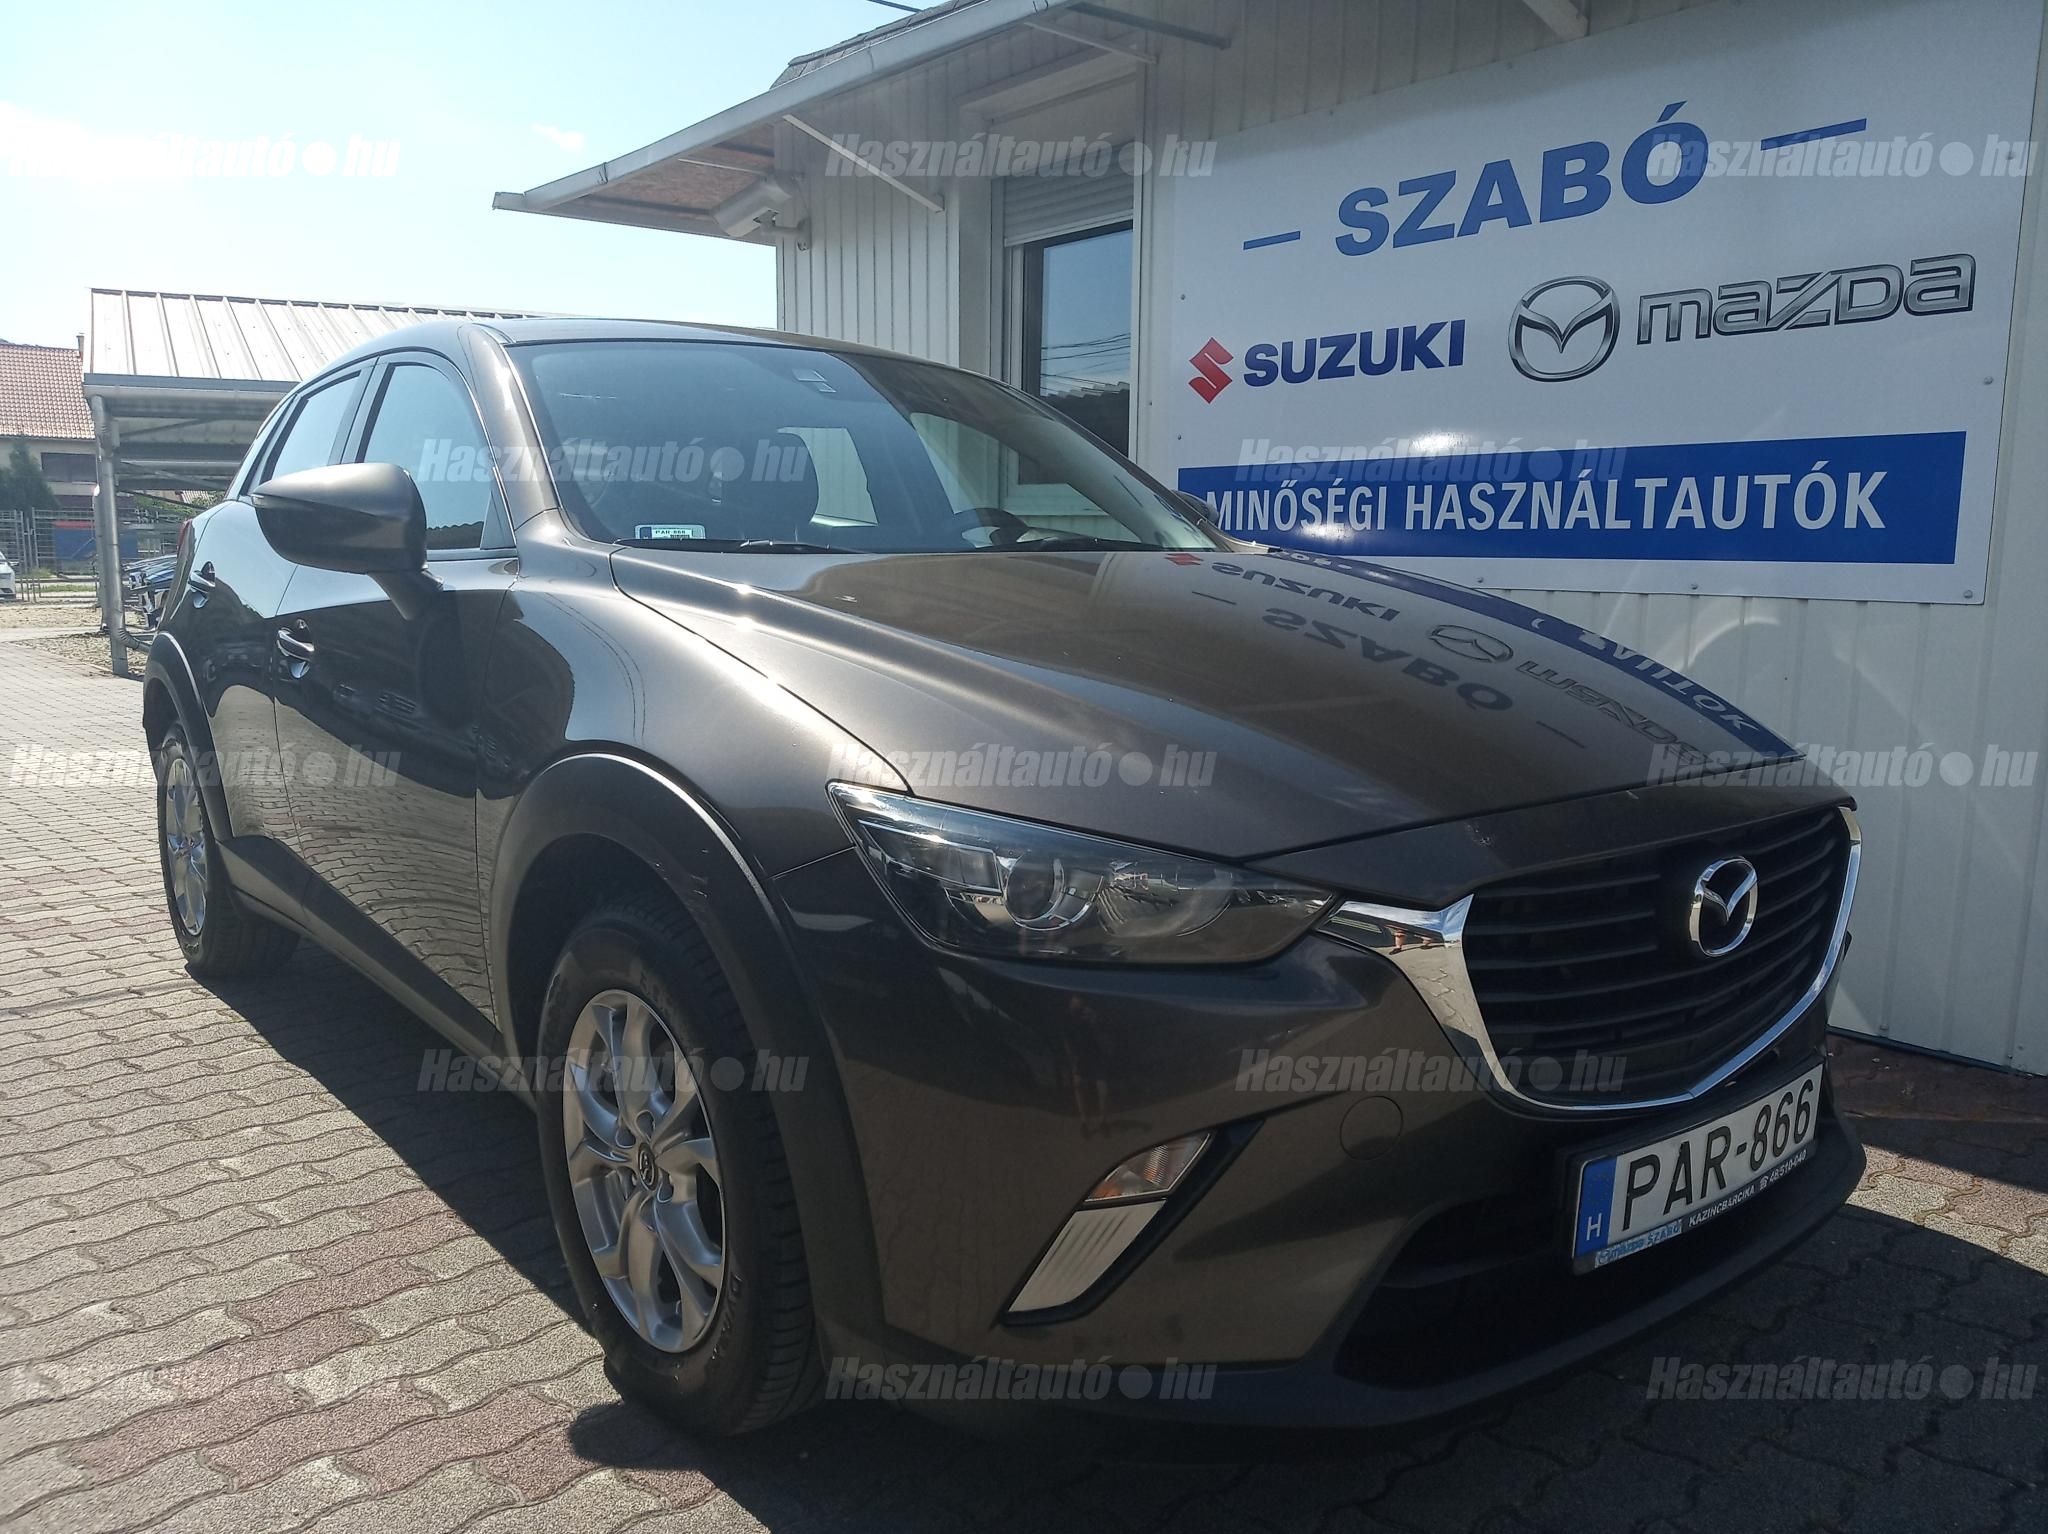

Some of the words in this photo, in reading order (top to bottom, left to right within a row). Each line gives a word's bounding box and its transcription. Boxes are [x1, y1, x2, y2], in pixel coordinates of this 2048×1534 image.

[1334, 100, 1710, 257] SZABÓ
[1637, 253, 1976, 345] mazda
[1243, 319, 1465, 388] SUZUKI
[1204, 477, 1388, 532] MINŐSÉGI
[1404, 460, 1887, 532] HASZNÁLTAUTÓK
[1621, 1078, 1814, 1232] PAR-866
[1586, 1212, 1602, 1241] H
